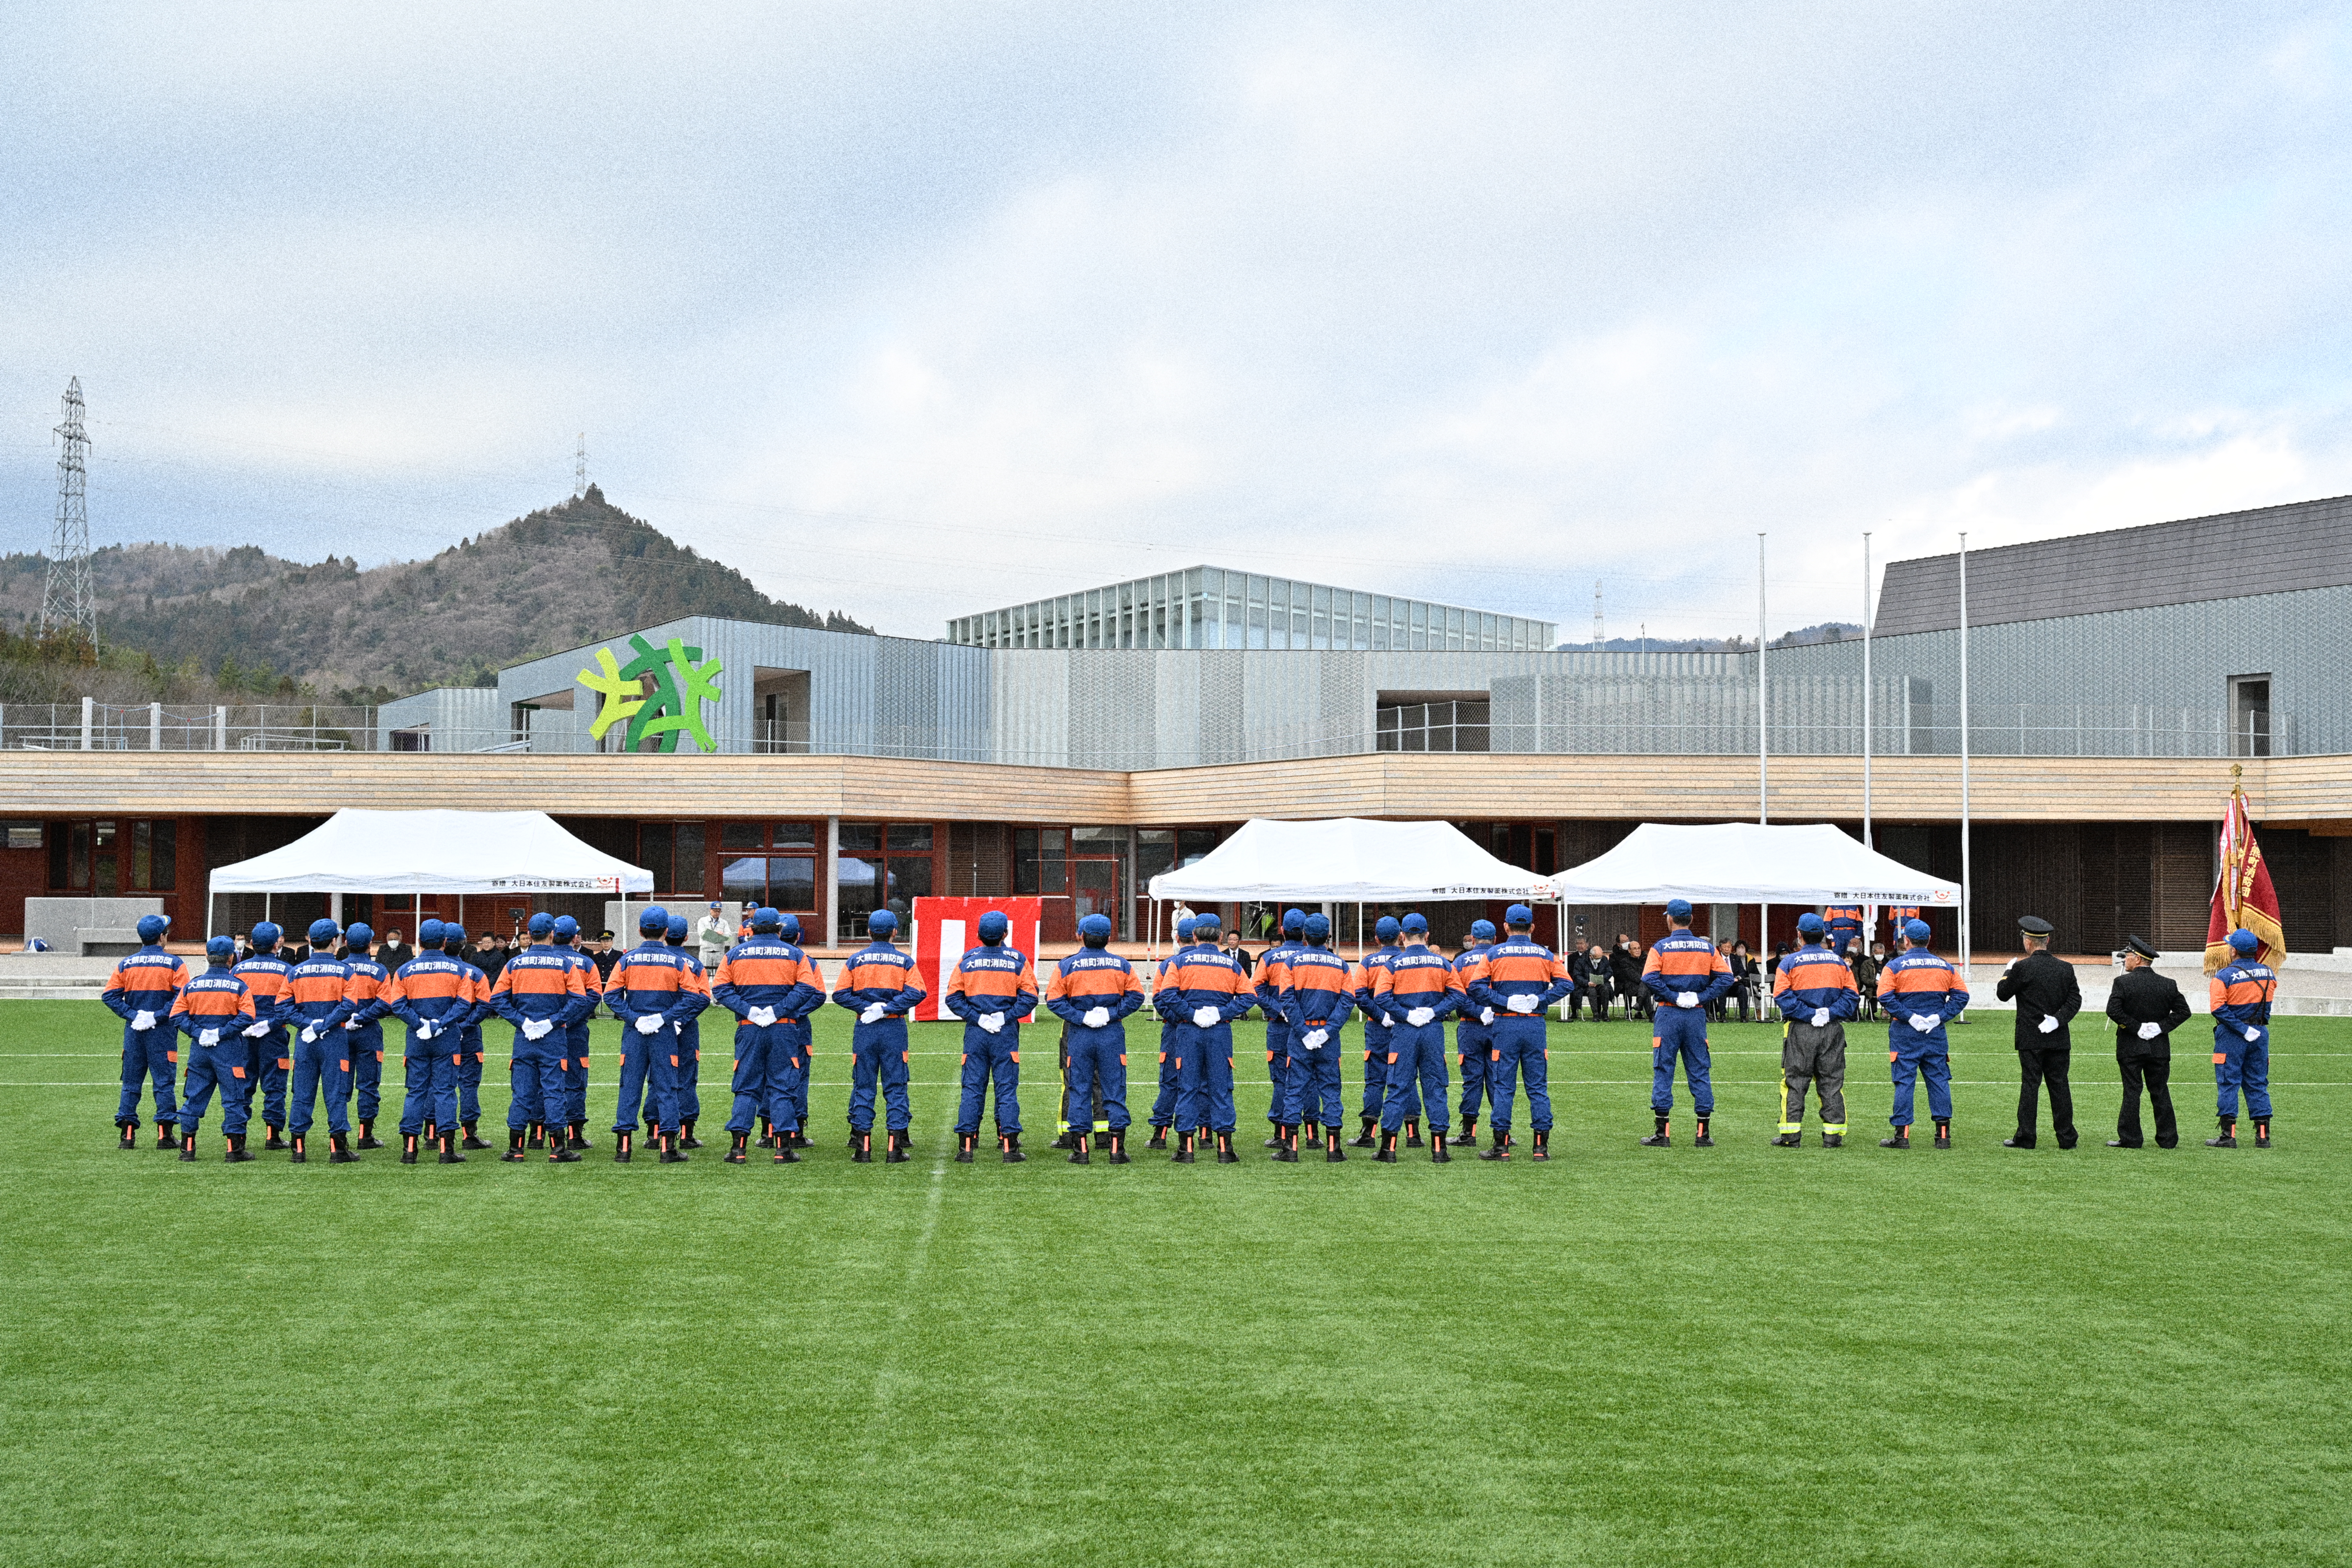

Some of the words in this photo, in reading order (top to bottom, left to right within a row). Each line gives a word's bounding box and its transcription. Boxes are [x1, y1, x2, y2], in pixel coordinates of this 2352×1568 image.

[2242, 838, 2261, 898] 熊町消防団
[1853, 892, 1930, 902] 大日本住友製薬株式会社
[1663, 940, 1709, 950] 大熊町消防団
[738, 946, 789, 956] 大熊町消防団
[1497, 946, 1546, 956] 大熊町消防団
[123, 955, 173, 965] 大熊町消防団
[513, 956, 564, 967] 大熊町消防団
[626, 953, 676, 964] 大熊町消防団
[856, 953, 905, 964] 大熊町消防団
[966, 958, 1015, 969] 大熊町消防団
[1072, 957, 1121, 969] 大熊町消防団
[1185, 954, 1234, 966] 大熊町消防団
[1294, 954, 1342, 966] 大熊町消防団
[1394, 955, 1443, 968] 大熊町消防団
[1794, 953, 1840, 963] 大熊町消防団
[1900, 958, 1947, 968] 大熊町消防団
[236, 962, 286, 972] 大熊町消防団
[295, 964, 345, 975] 大熊町消防団
[408, 961, 458, 973] 大熊町消防団
[188, 979, 240, 990] 大熊町消防団
